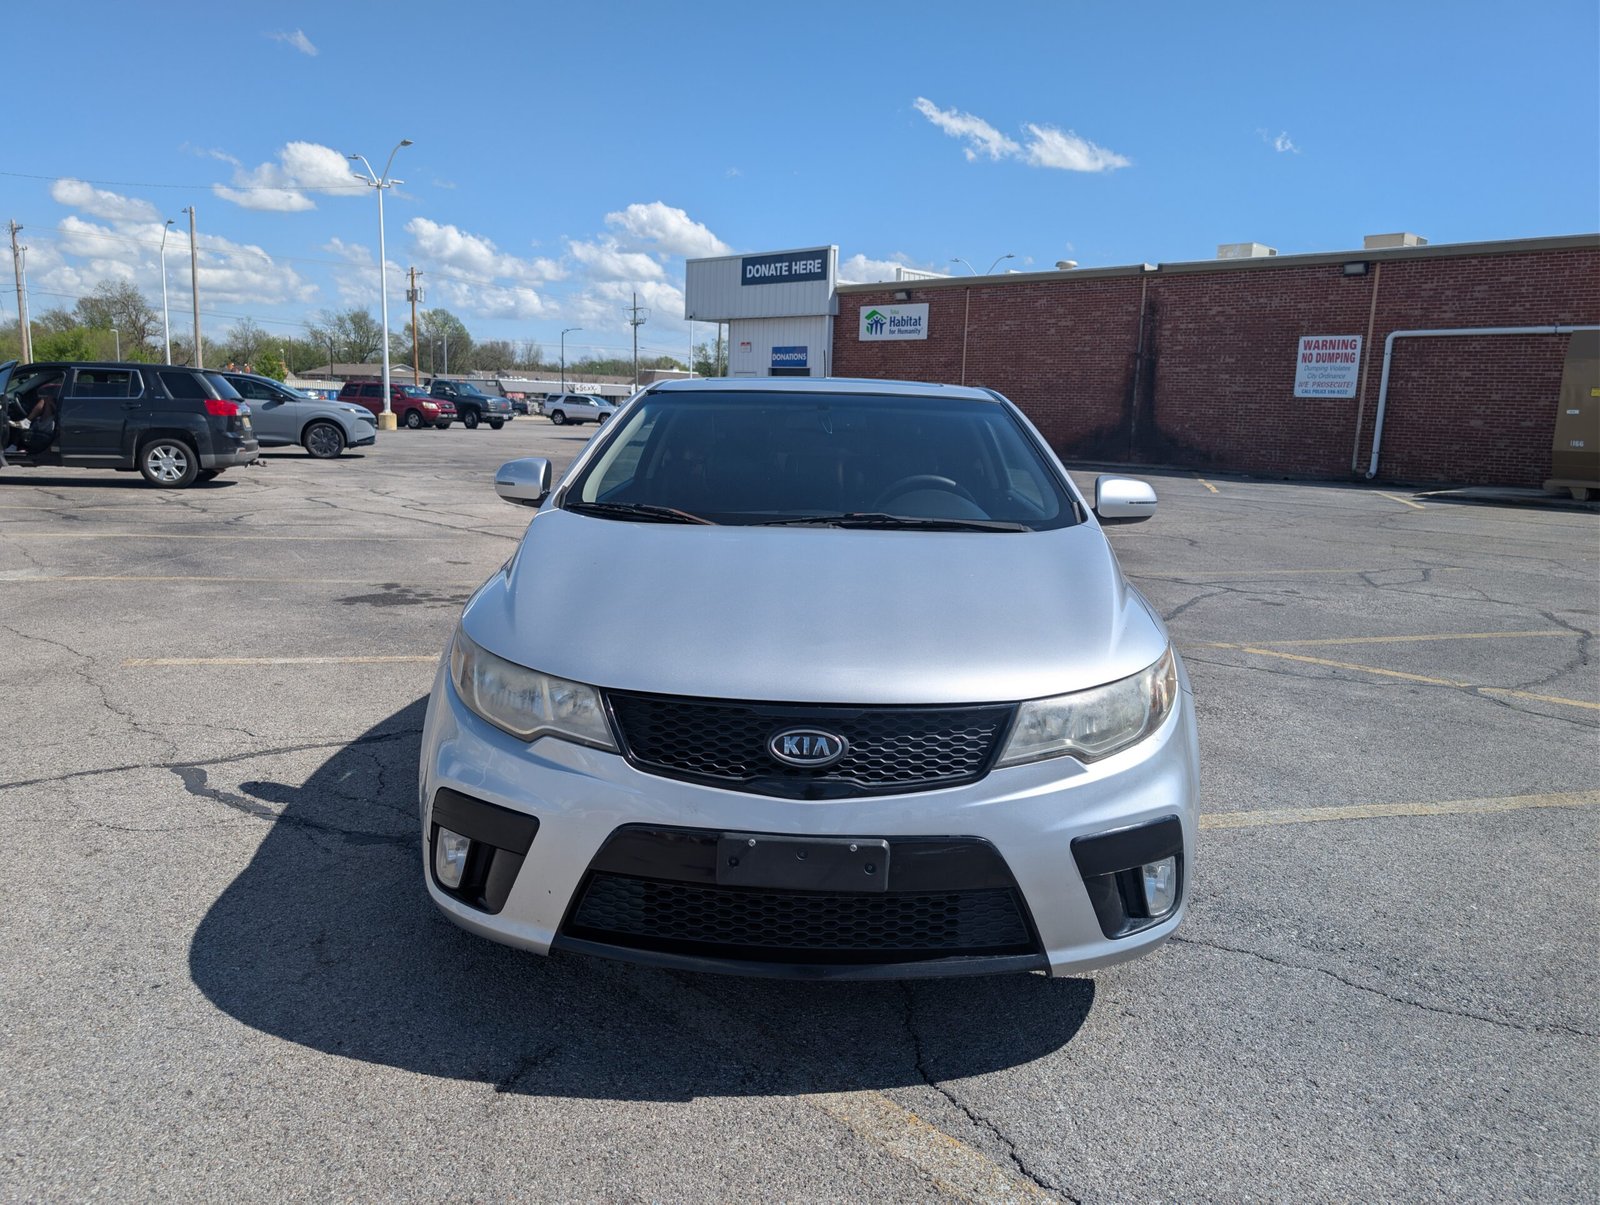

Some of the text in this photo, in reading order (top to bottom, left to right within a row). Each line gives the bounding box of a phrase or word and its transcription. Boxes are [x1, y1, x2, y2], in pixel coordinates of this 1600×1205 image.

[746, 259, 822, 278] DONATE HERE
[889, 315, 921, 328] Habitat
[897, 327, 921, 336] Humanity
[1304, 339, 1357, 350] WARNING
[772, 352, 807, 361] DONATIONS
[1302, 353, 1355, 363] NO DUMPING
[783, 736, 830, 755] KIA
